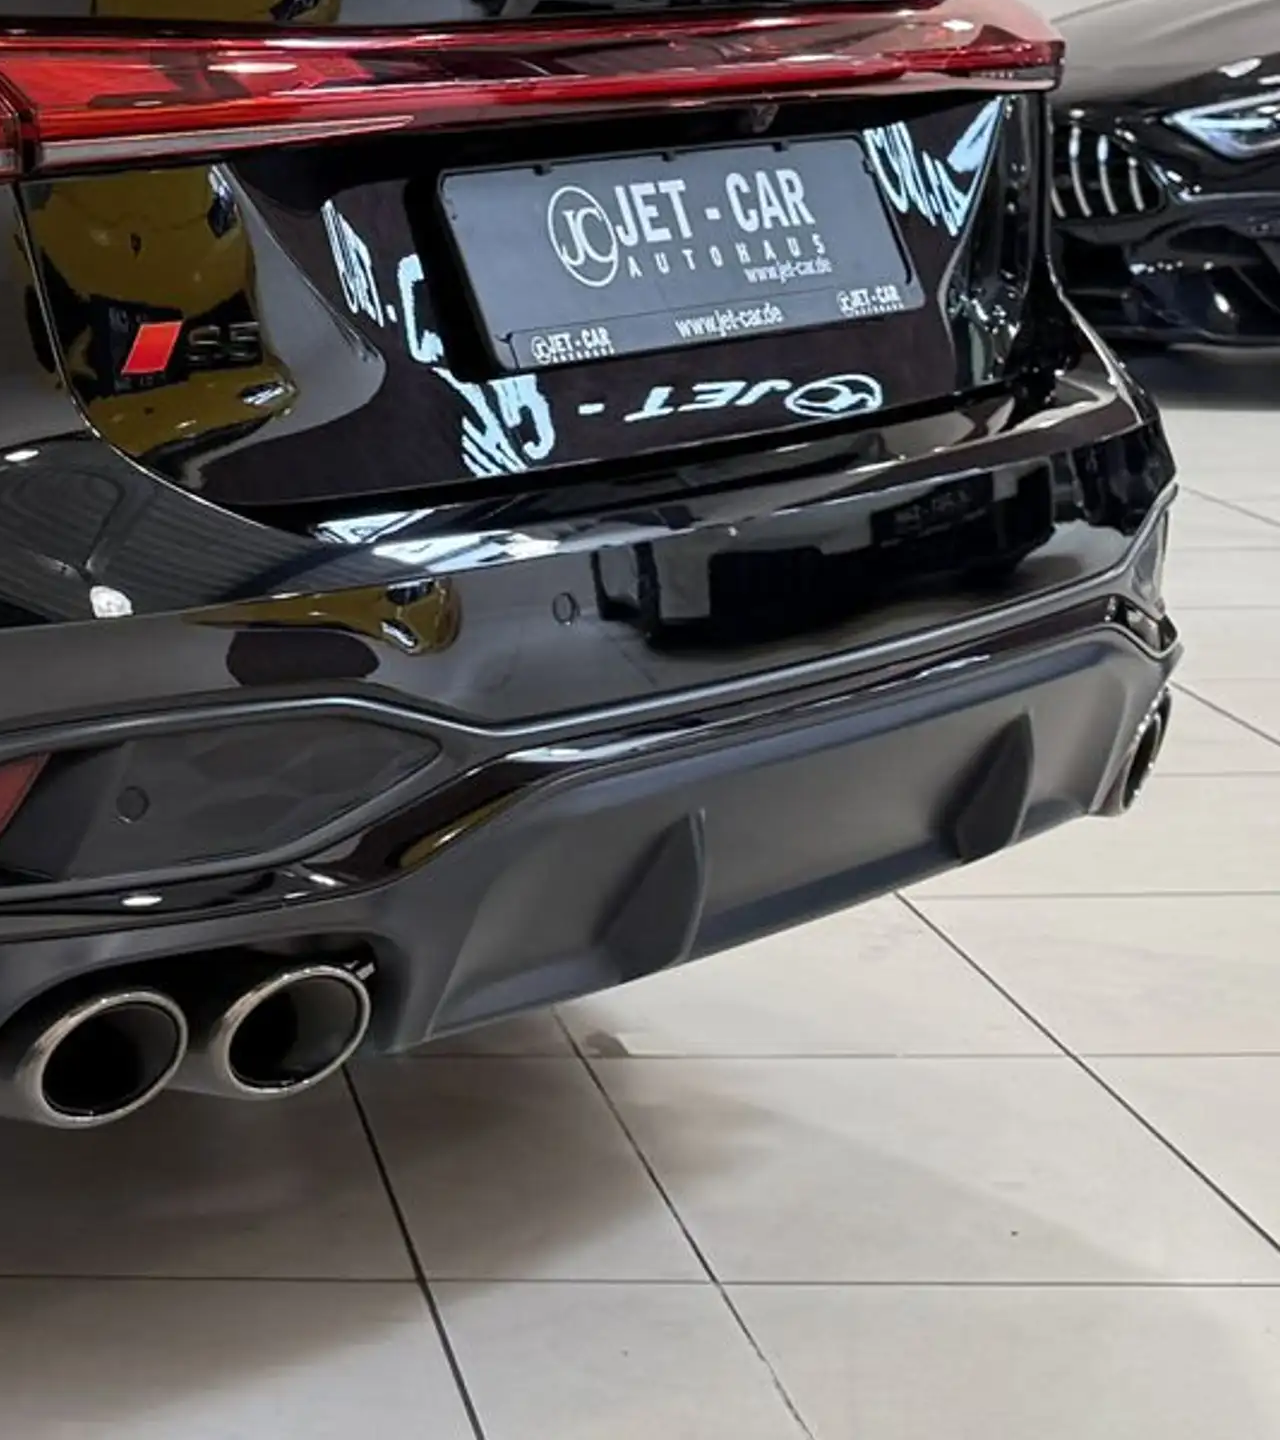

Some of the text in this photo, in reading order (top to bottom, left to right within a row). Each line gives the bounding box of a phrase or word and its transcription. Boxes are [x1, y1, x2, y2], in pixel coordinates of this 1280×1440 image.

[614, 179, 693, 247] JET
[724, 168, 816, 233] CAR
[626, 232, 827, 279] AUTOHAUS
[743, 255, 833, 284] www.jet-car.de
[674, 301, 785, 339] www.jet-car.de
